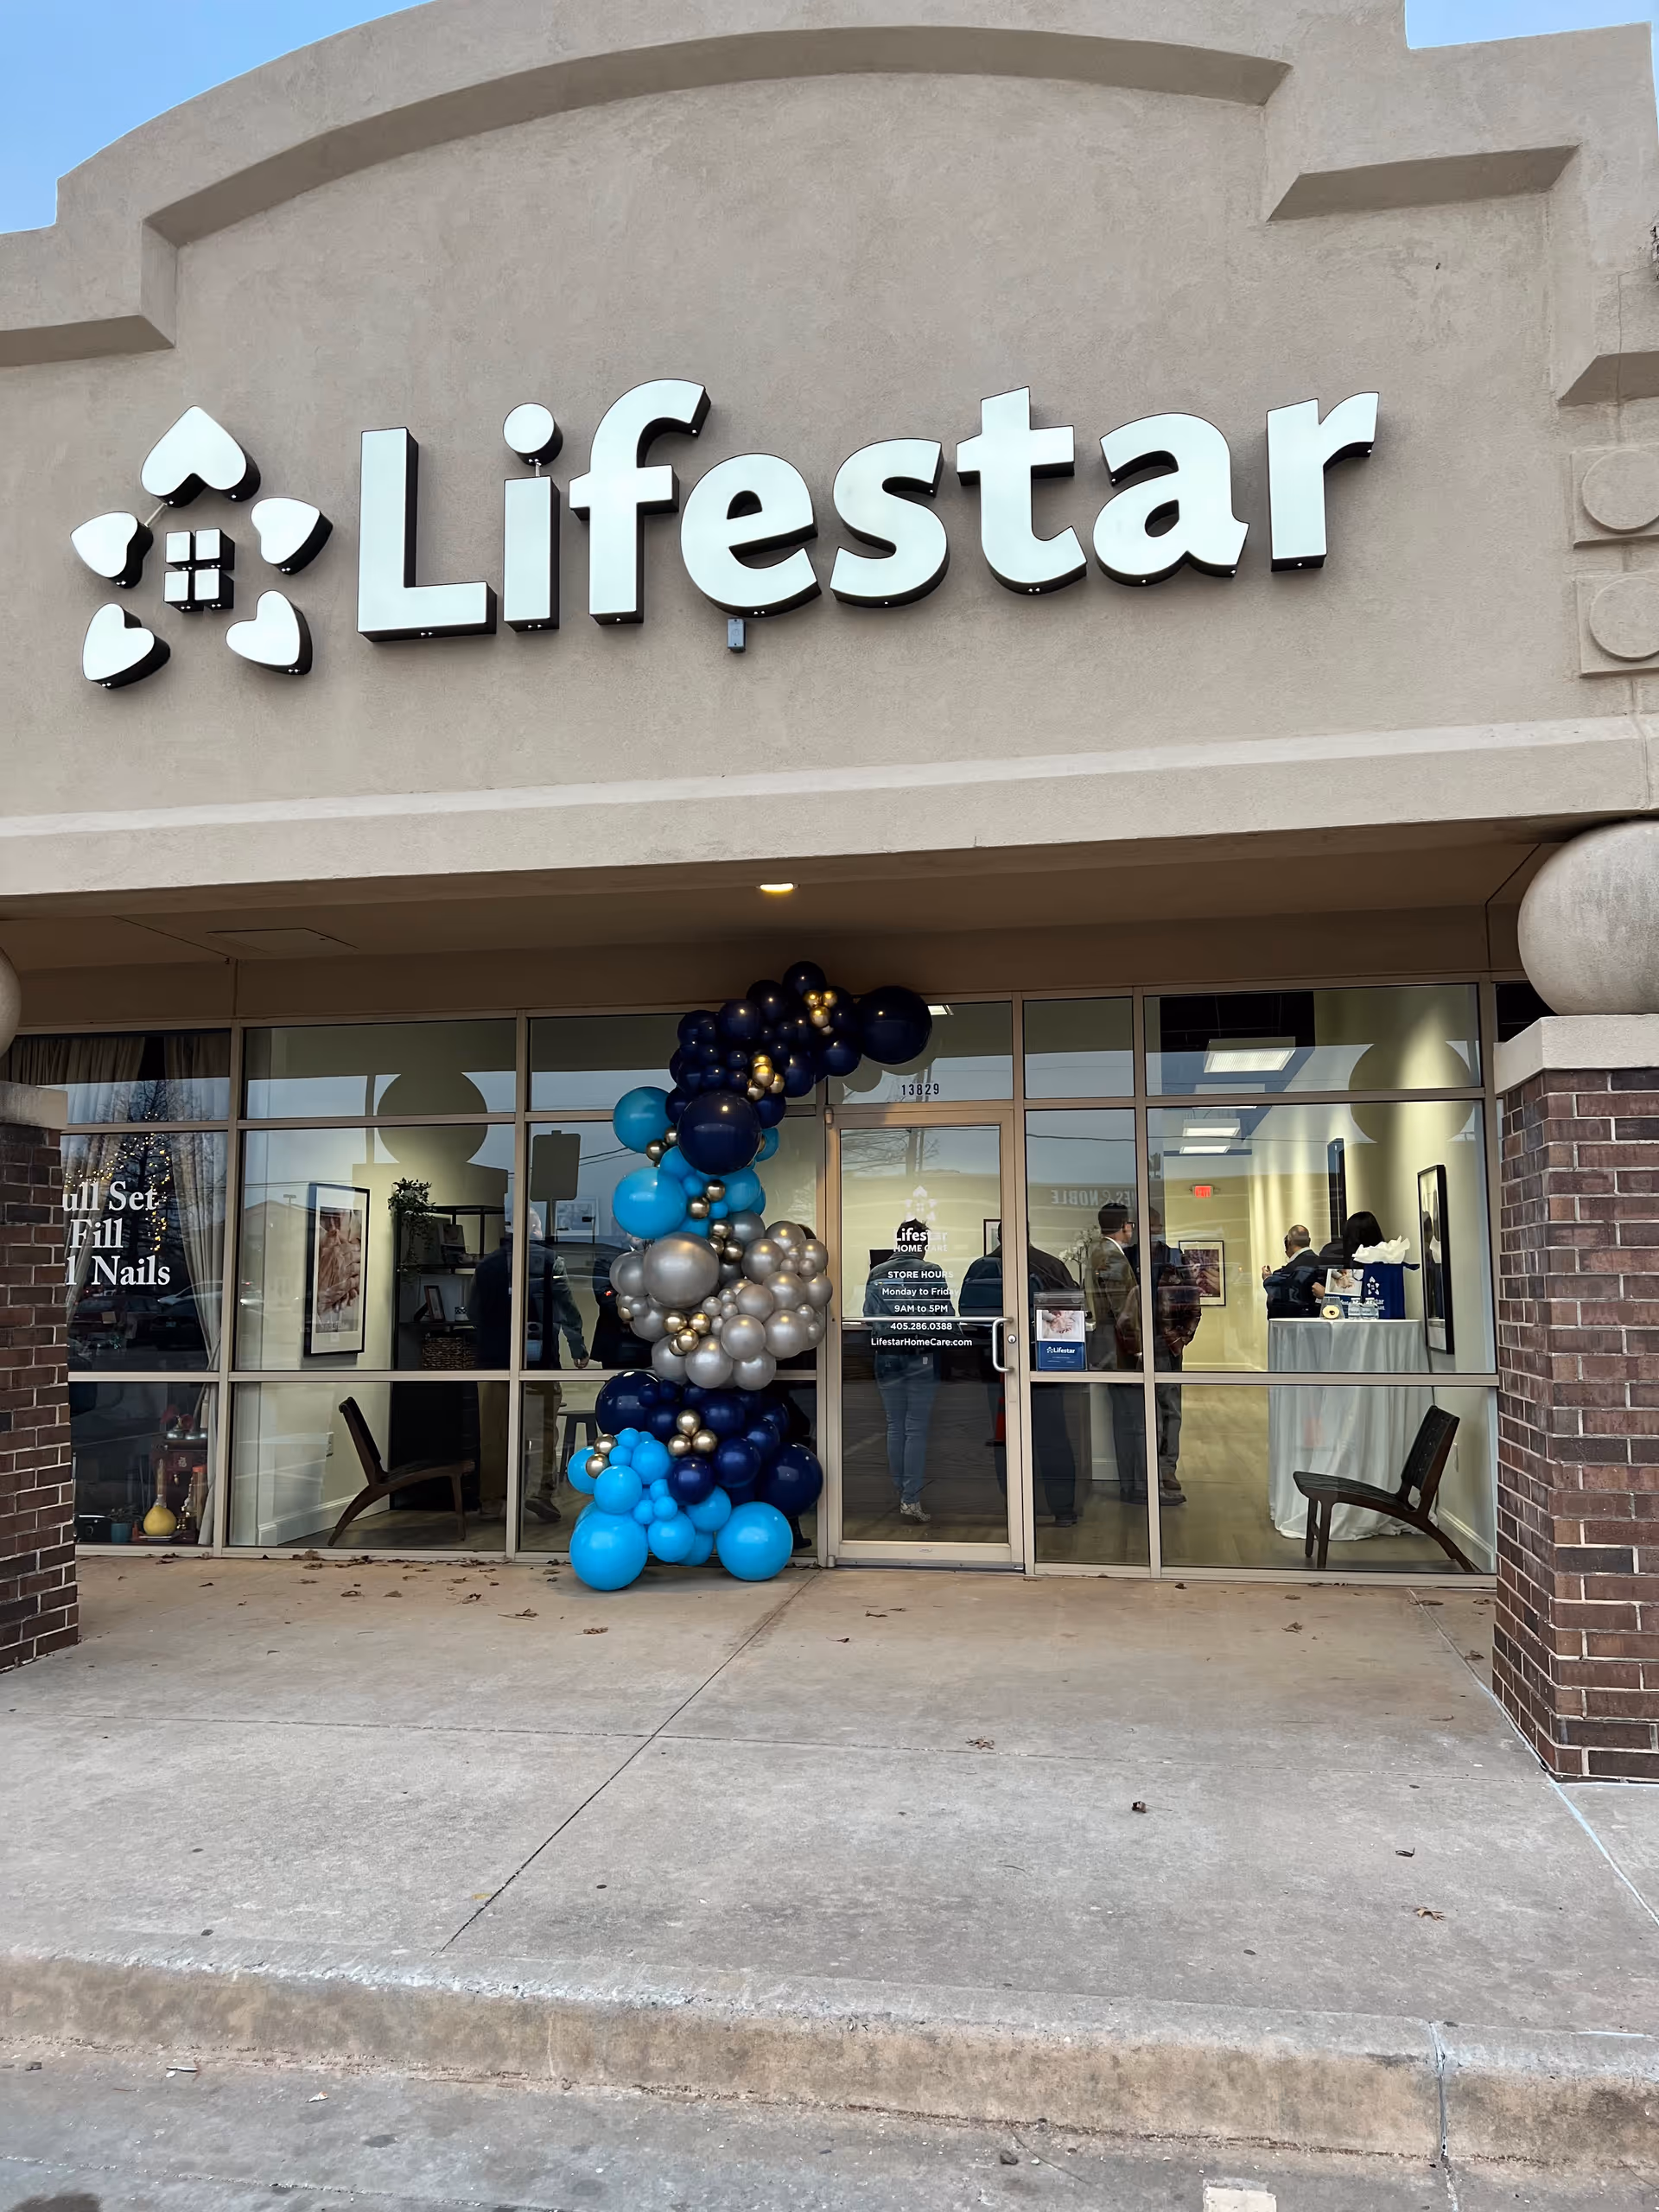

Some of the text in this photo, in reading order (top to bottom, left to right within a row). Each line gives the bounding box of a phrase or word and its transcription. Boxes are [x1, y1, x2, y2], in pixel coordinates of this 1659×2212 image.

[357, 378, 1380, 642] Lifestar
[901, 1083, 939, 1096] 13829
[62, 1180, 158, 1211] ull Set
[69, 1217, 124, 1249] Fill
[91, 1255, 170, 1286] Nails
[882, 1287, 917, 1296] Monday
[931, 1287, 959, 1296] Friday
[871, 1338, 973, 1346] LifestarHomeCare.com
